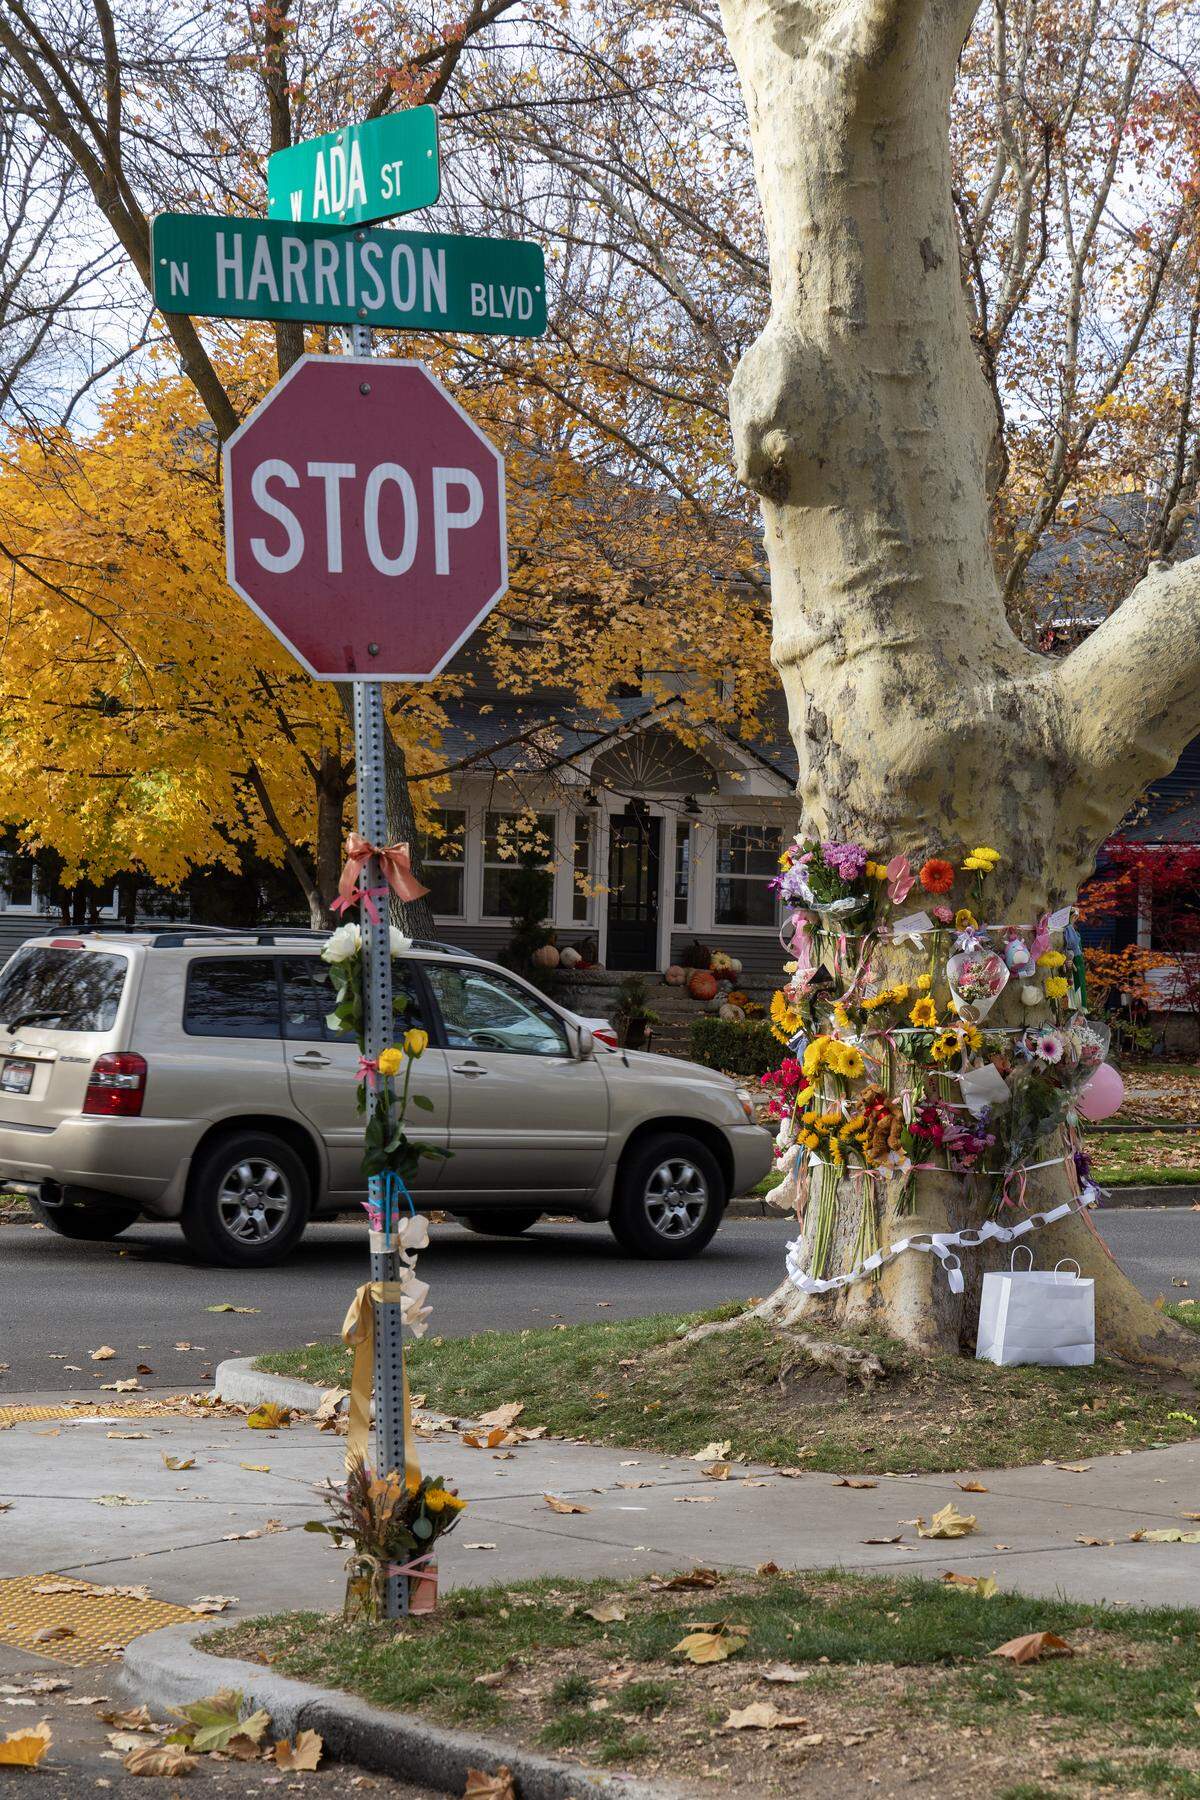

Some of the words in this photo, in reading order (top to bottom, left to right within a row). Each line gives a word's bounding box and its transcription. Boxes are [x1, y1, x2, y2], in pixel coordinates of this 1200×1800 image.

[290, 190, 303, 222] W
[312, 140, 367, 219] ADA
[380, 160, 403, 200] ST
[169, 261, 190, 297] N
[215, 231, 448, 314] HARRISON
[470, 282, 534, 321] BLVD
[249, 458, 485, 577] STOP
